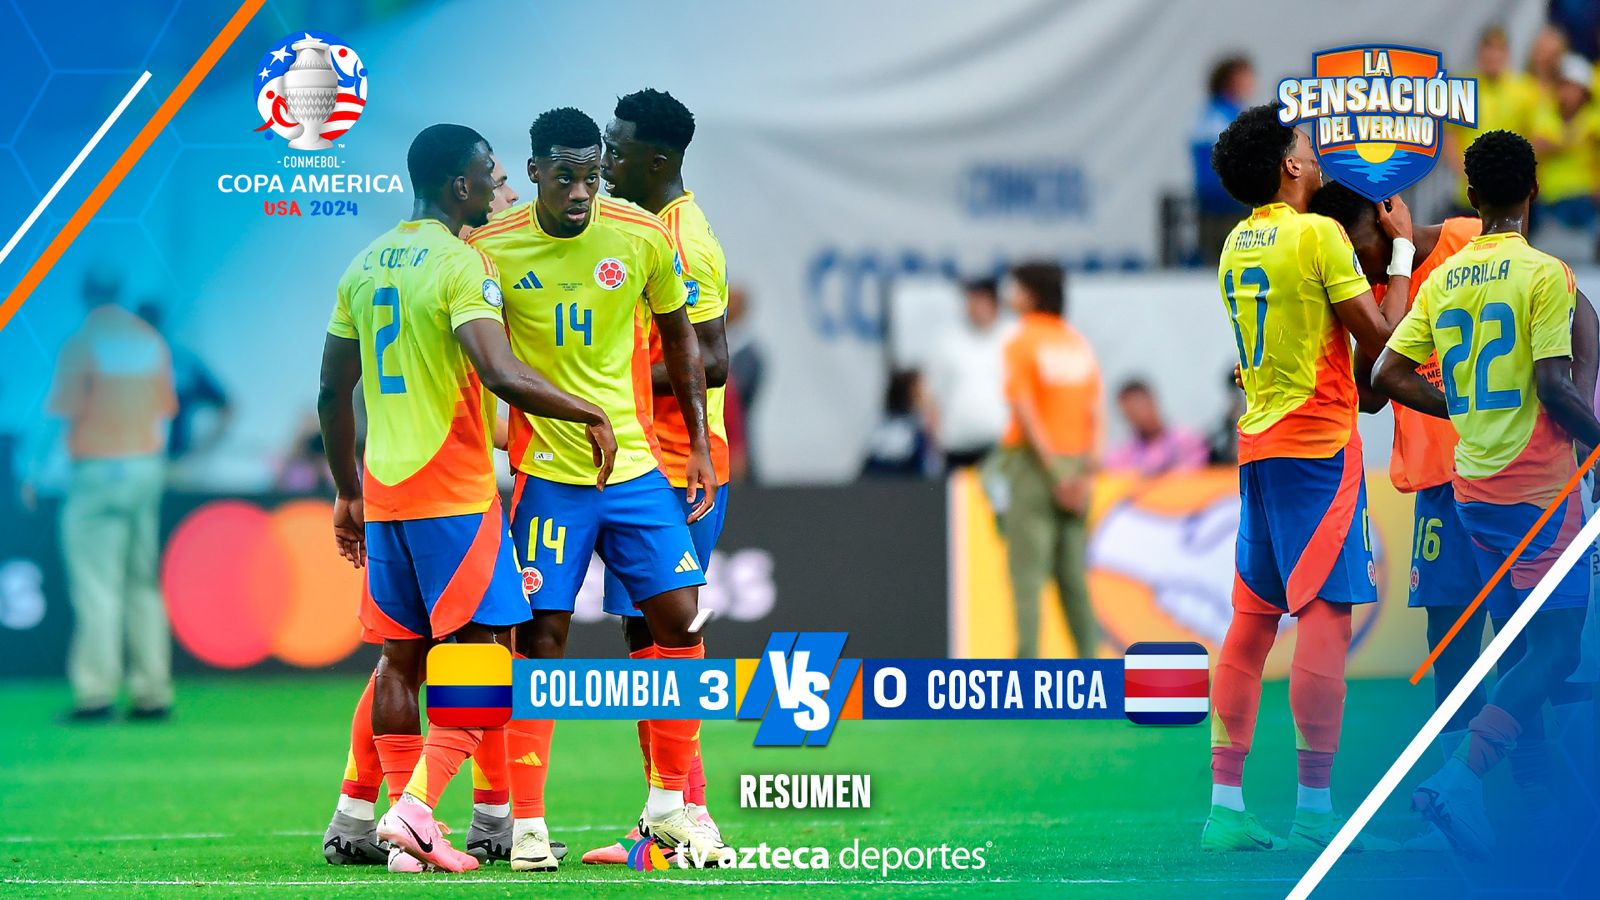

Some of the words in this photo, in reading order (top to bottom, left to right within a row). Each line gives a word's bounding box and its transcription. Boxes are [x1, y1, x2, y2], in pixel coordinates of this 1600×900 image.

[1446, 259, 1511, 291] ASPRILLA
[373, 287, 407, 394] 2
[555, 302, 592, 347] 14
[1224, 266, 1270, 371] 17
[1436, 302, 1522, 416] 22
[527, 516, 567, 565] 14
[1414, 516, 1443, 562] 16
